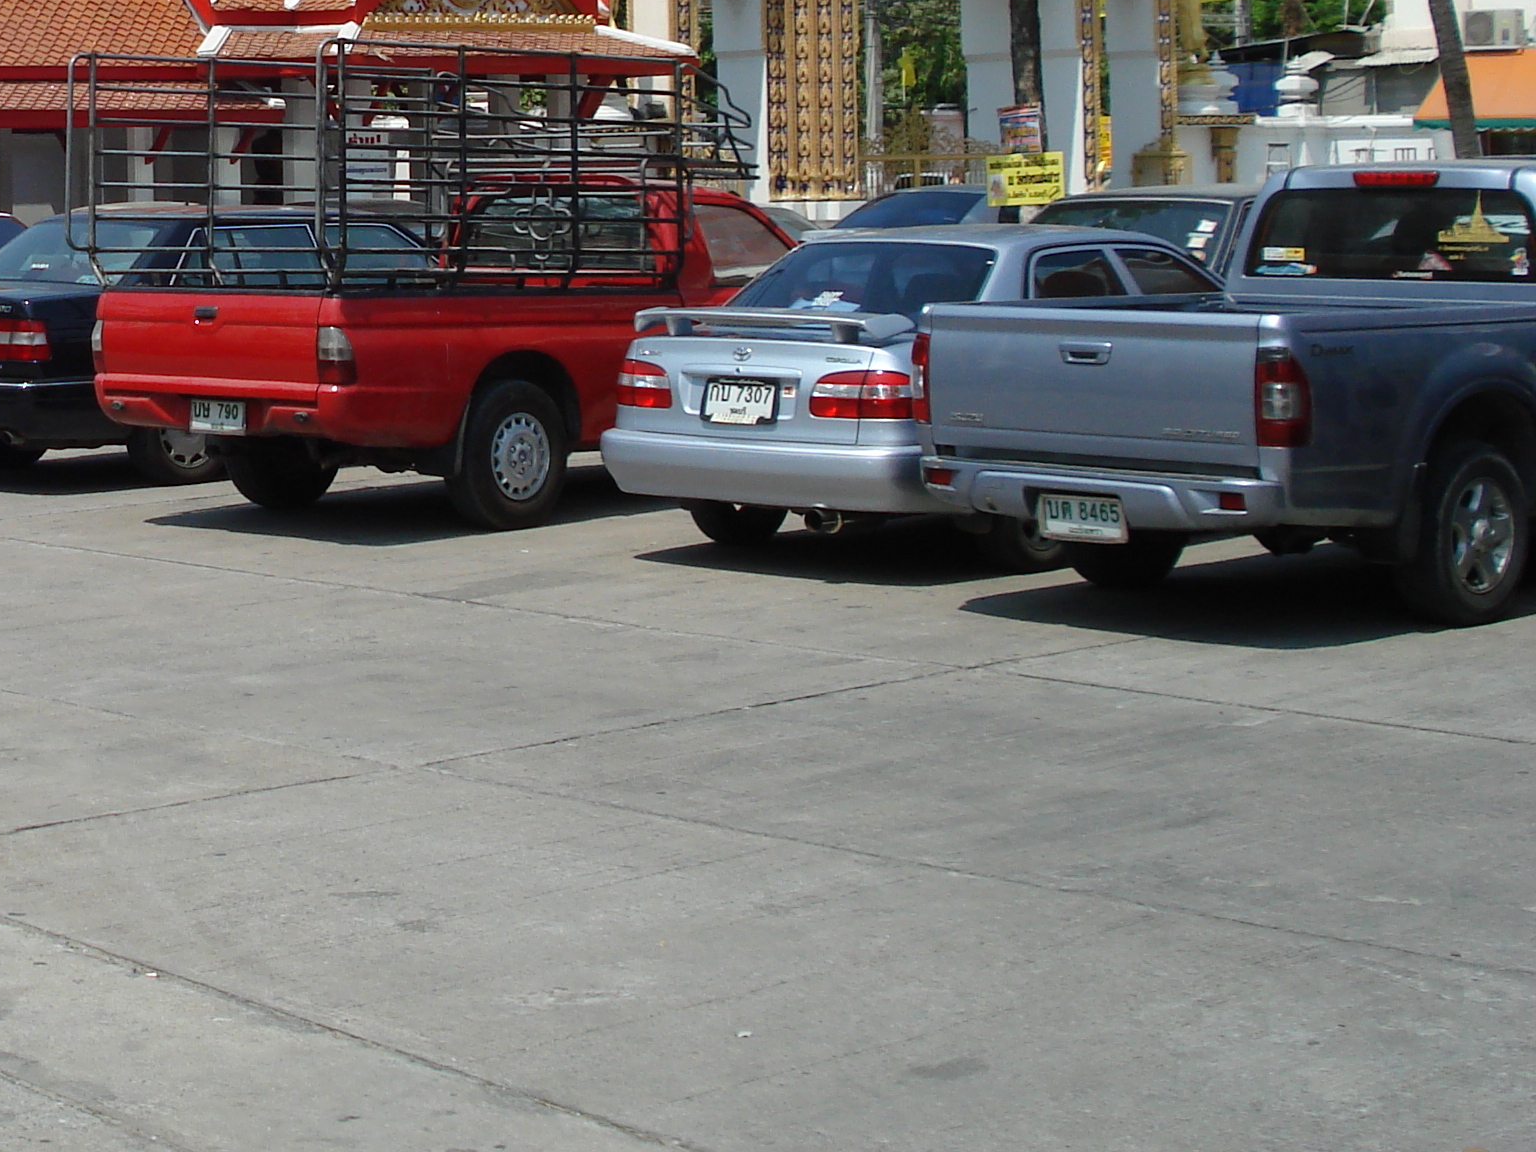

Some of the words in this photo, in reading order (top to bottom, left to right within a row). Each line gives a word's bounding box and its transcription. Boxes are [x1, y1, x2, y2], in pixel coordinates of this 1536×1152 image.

[736, 385, 772, 404] 7307
[217, 403, 239, 420] 790
[1078, 501, 1120, 523] 8465
